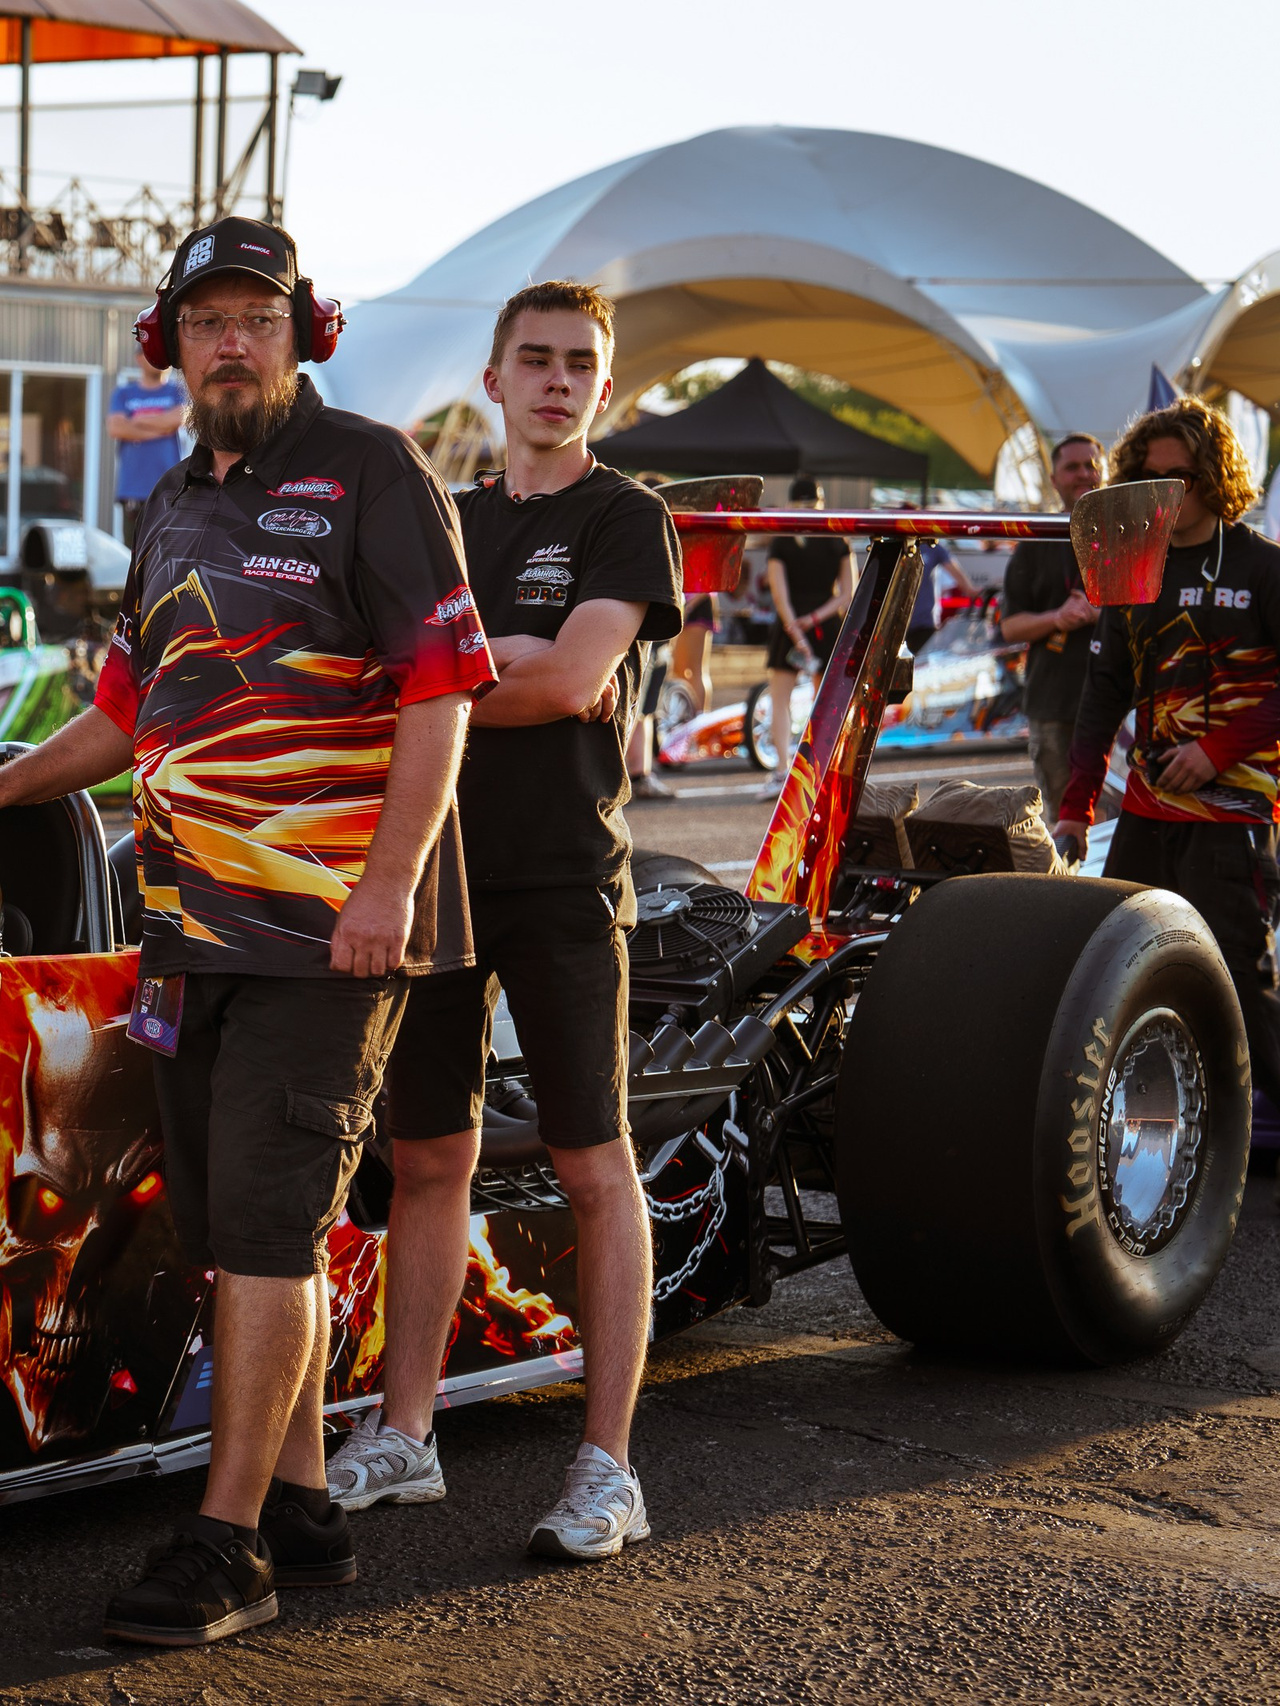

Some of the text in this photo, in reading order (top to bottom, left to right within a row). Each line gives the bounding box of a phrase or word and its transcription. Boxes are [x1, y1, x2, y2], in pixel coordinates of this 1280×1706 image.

[265, 526, 317, 537] SUPERCHARGERS
[437, 593, 470, 620] FLAMH
[1058, 1017, 1112, 1238] Hoosier
[1096, 1066, 1118, 1191] RACING
[1109, 1212, 1146, 1256] WELD
